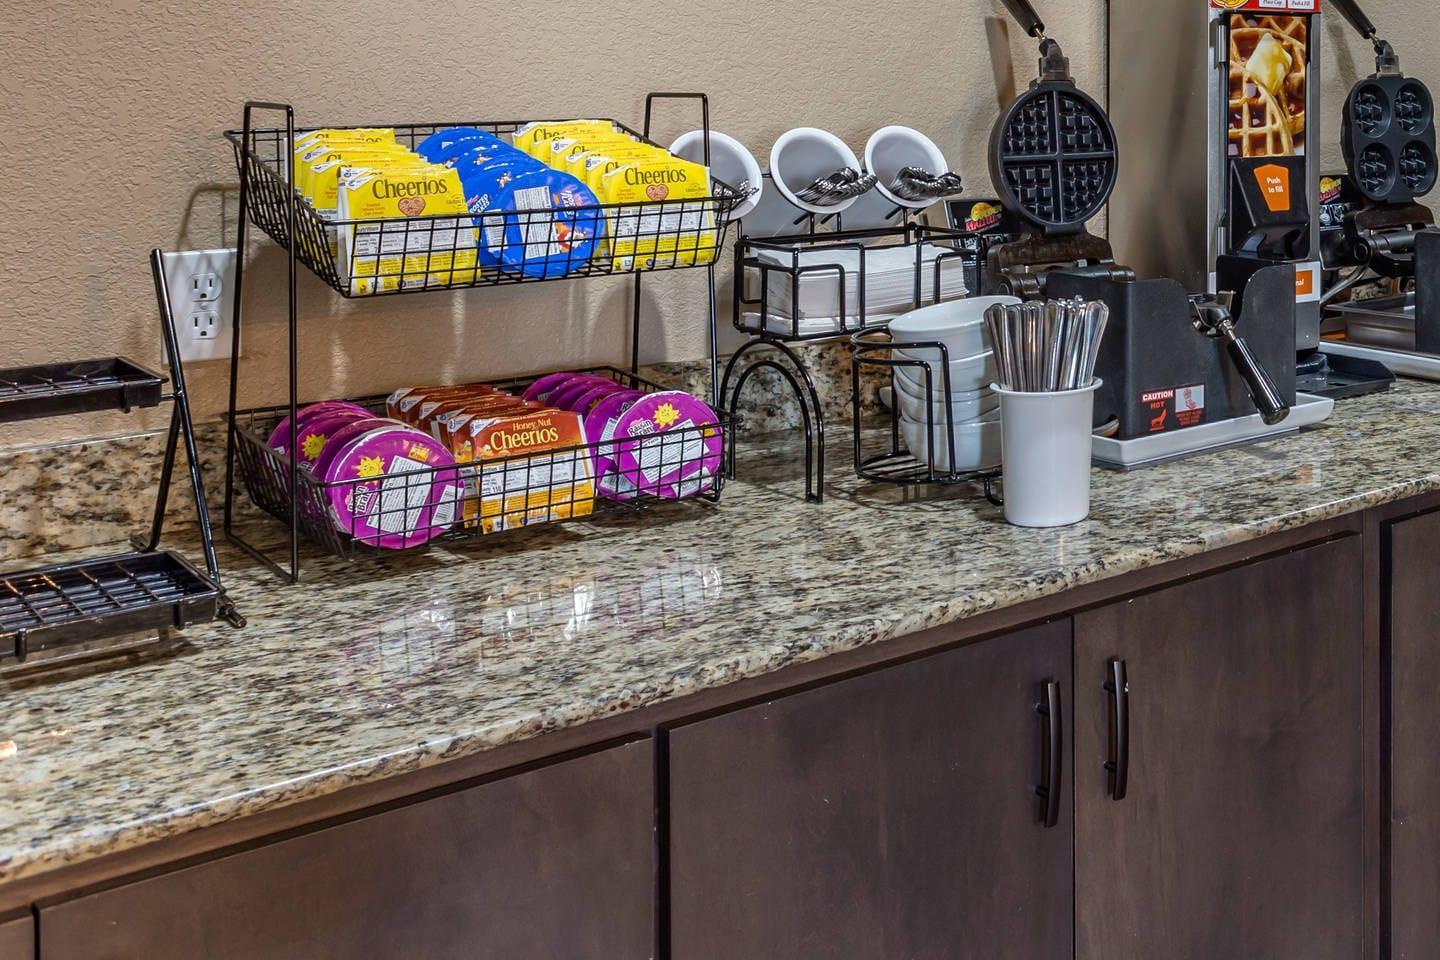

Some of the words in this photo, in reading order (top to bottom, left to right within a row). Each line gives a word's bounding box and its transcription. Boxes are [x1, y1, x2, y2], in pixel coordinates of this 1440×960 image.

[624, 166, 687, 186] Cheerios
[372, 176, 448, 200] Cheerios
[1142, 390, 1174, 401] CAUTION
[1150, 401, 1165, 409] HOT
[512, 421, 537, 432] Honey
[538, 418, 552, 428] Nut
[628, 420, 652, 436] Raisin
[490, 426, 559, 451] Cheerios
